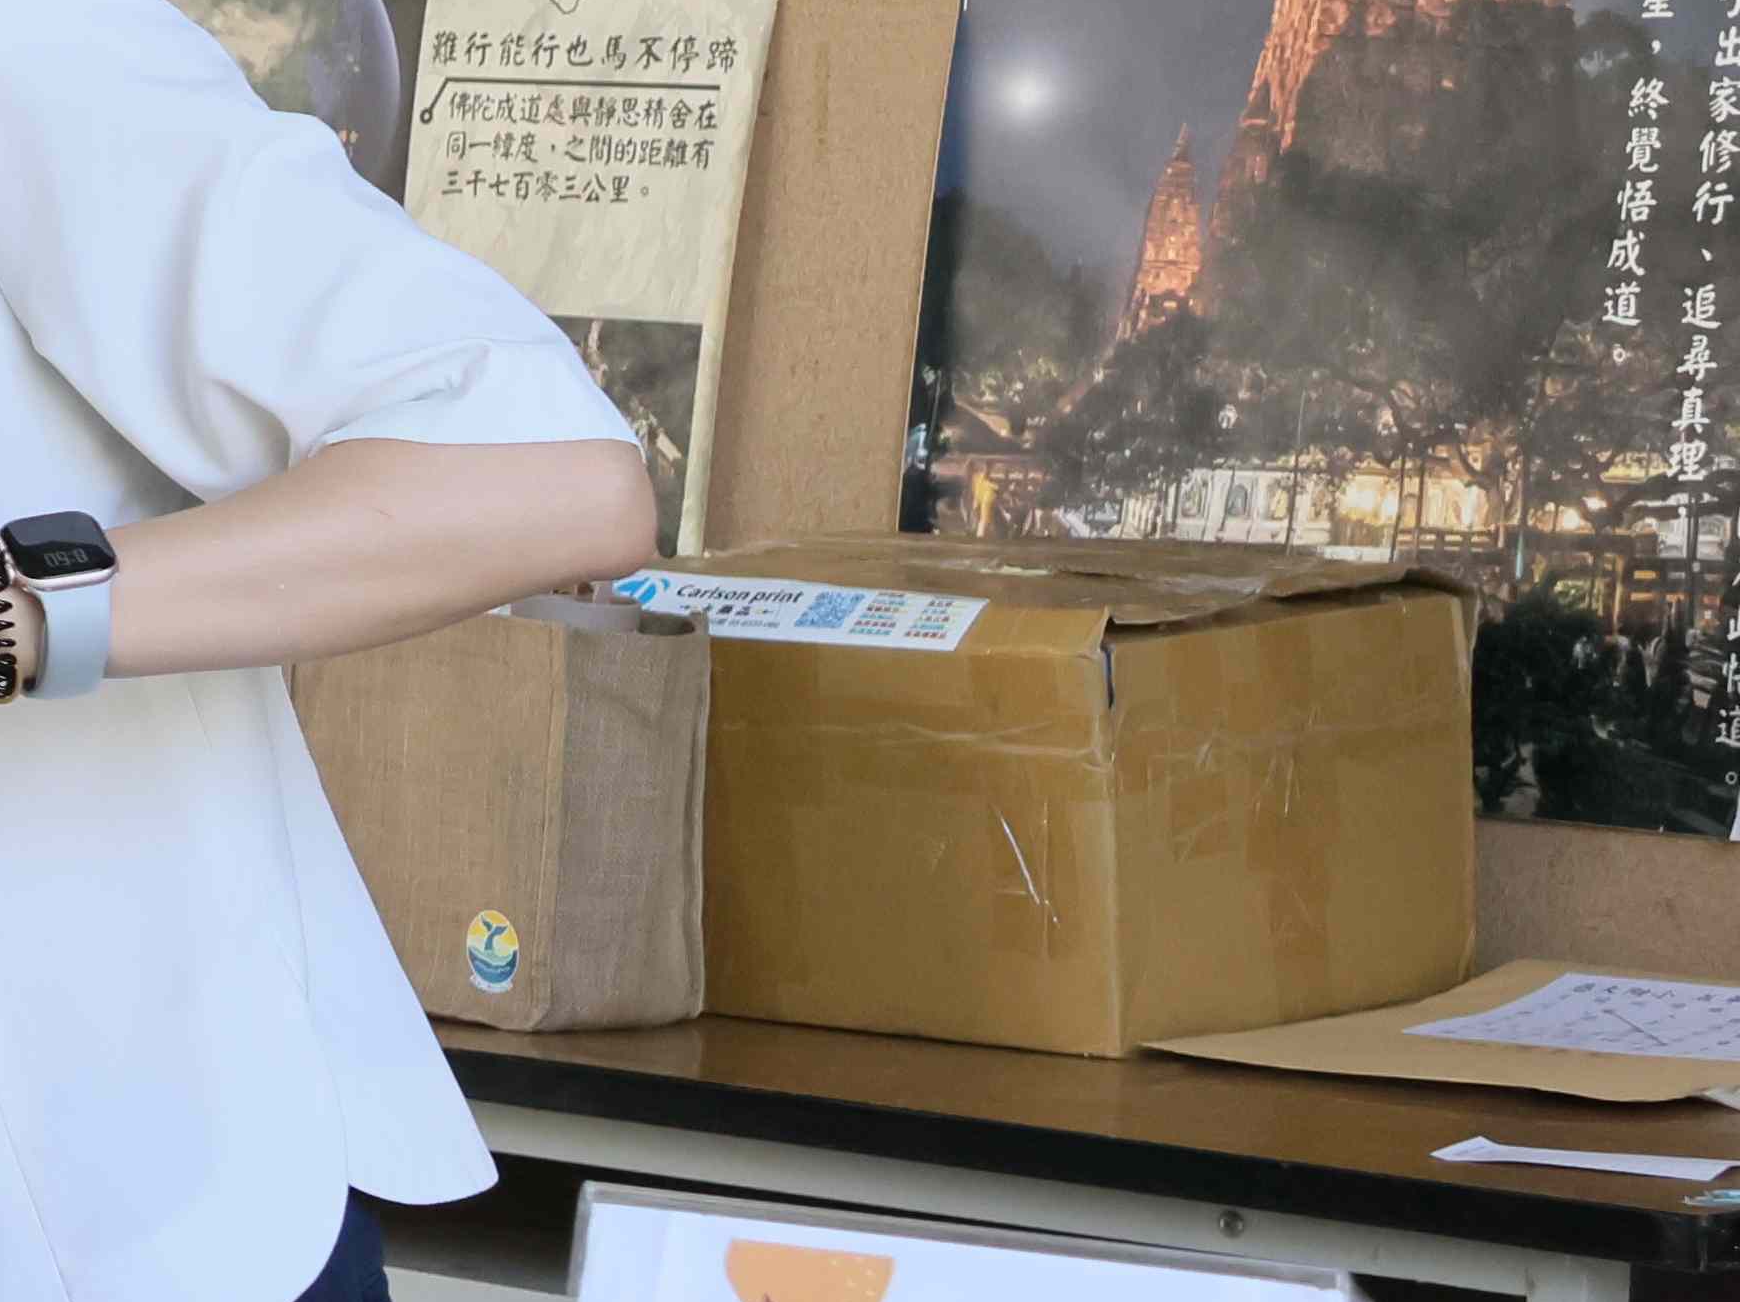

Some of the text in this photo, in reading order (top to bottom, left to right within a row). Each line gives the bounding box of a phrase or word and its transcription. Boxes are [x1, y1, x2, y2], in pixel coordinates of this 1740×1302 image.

[432, 30, 738, 74] 難行能行也馬不停蹄
[448, 91, 718, 130] 佛陀成道處與靜思精舍在
[445, 130, 716, 171] 同一緯度，之間的距離有
[441, 169, 650, 203] 三千七百零三公里。
[676, 583, 805, 606] Carlson print
